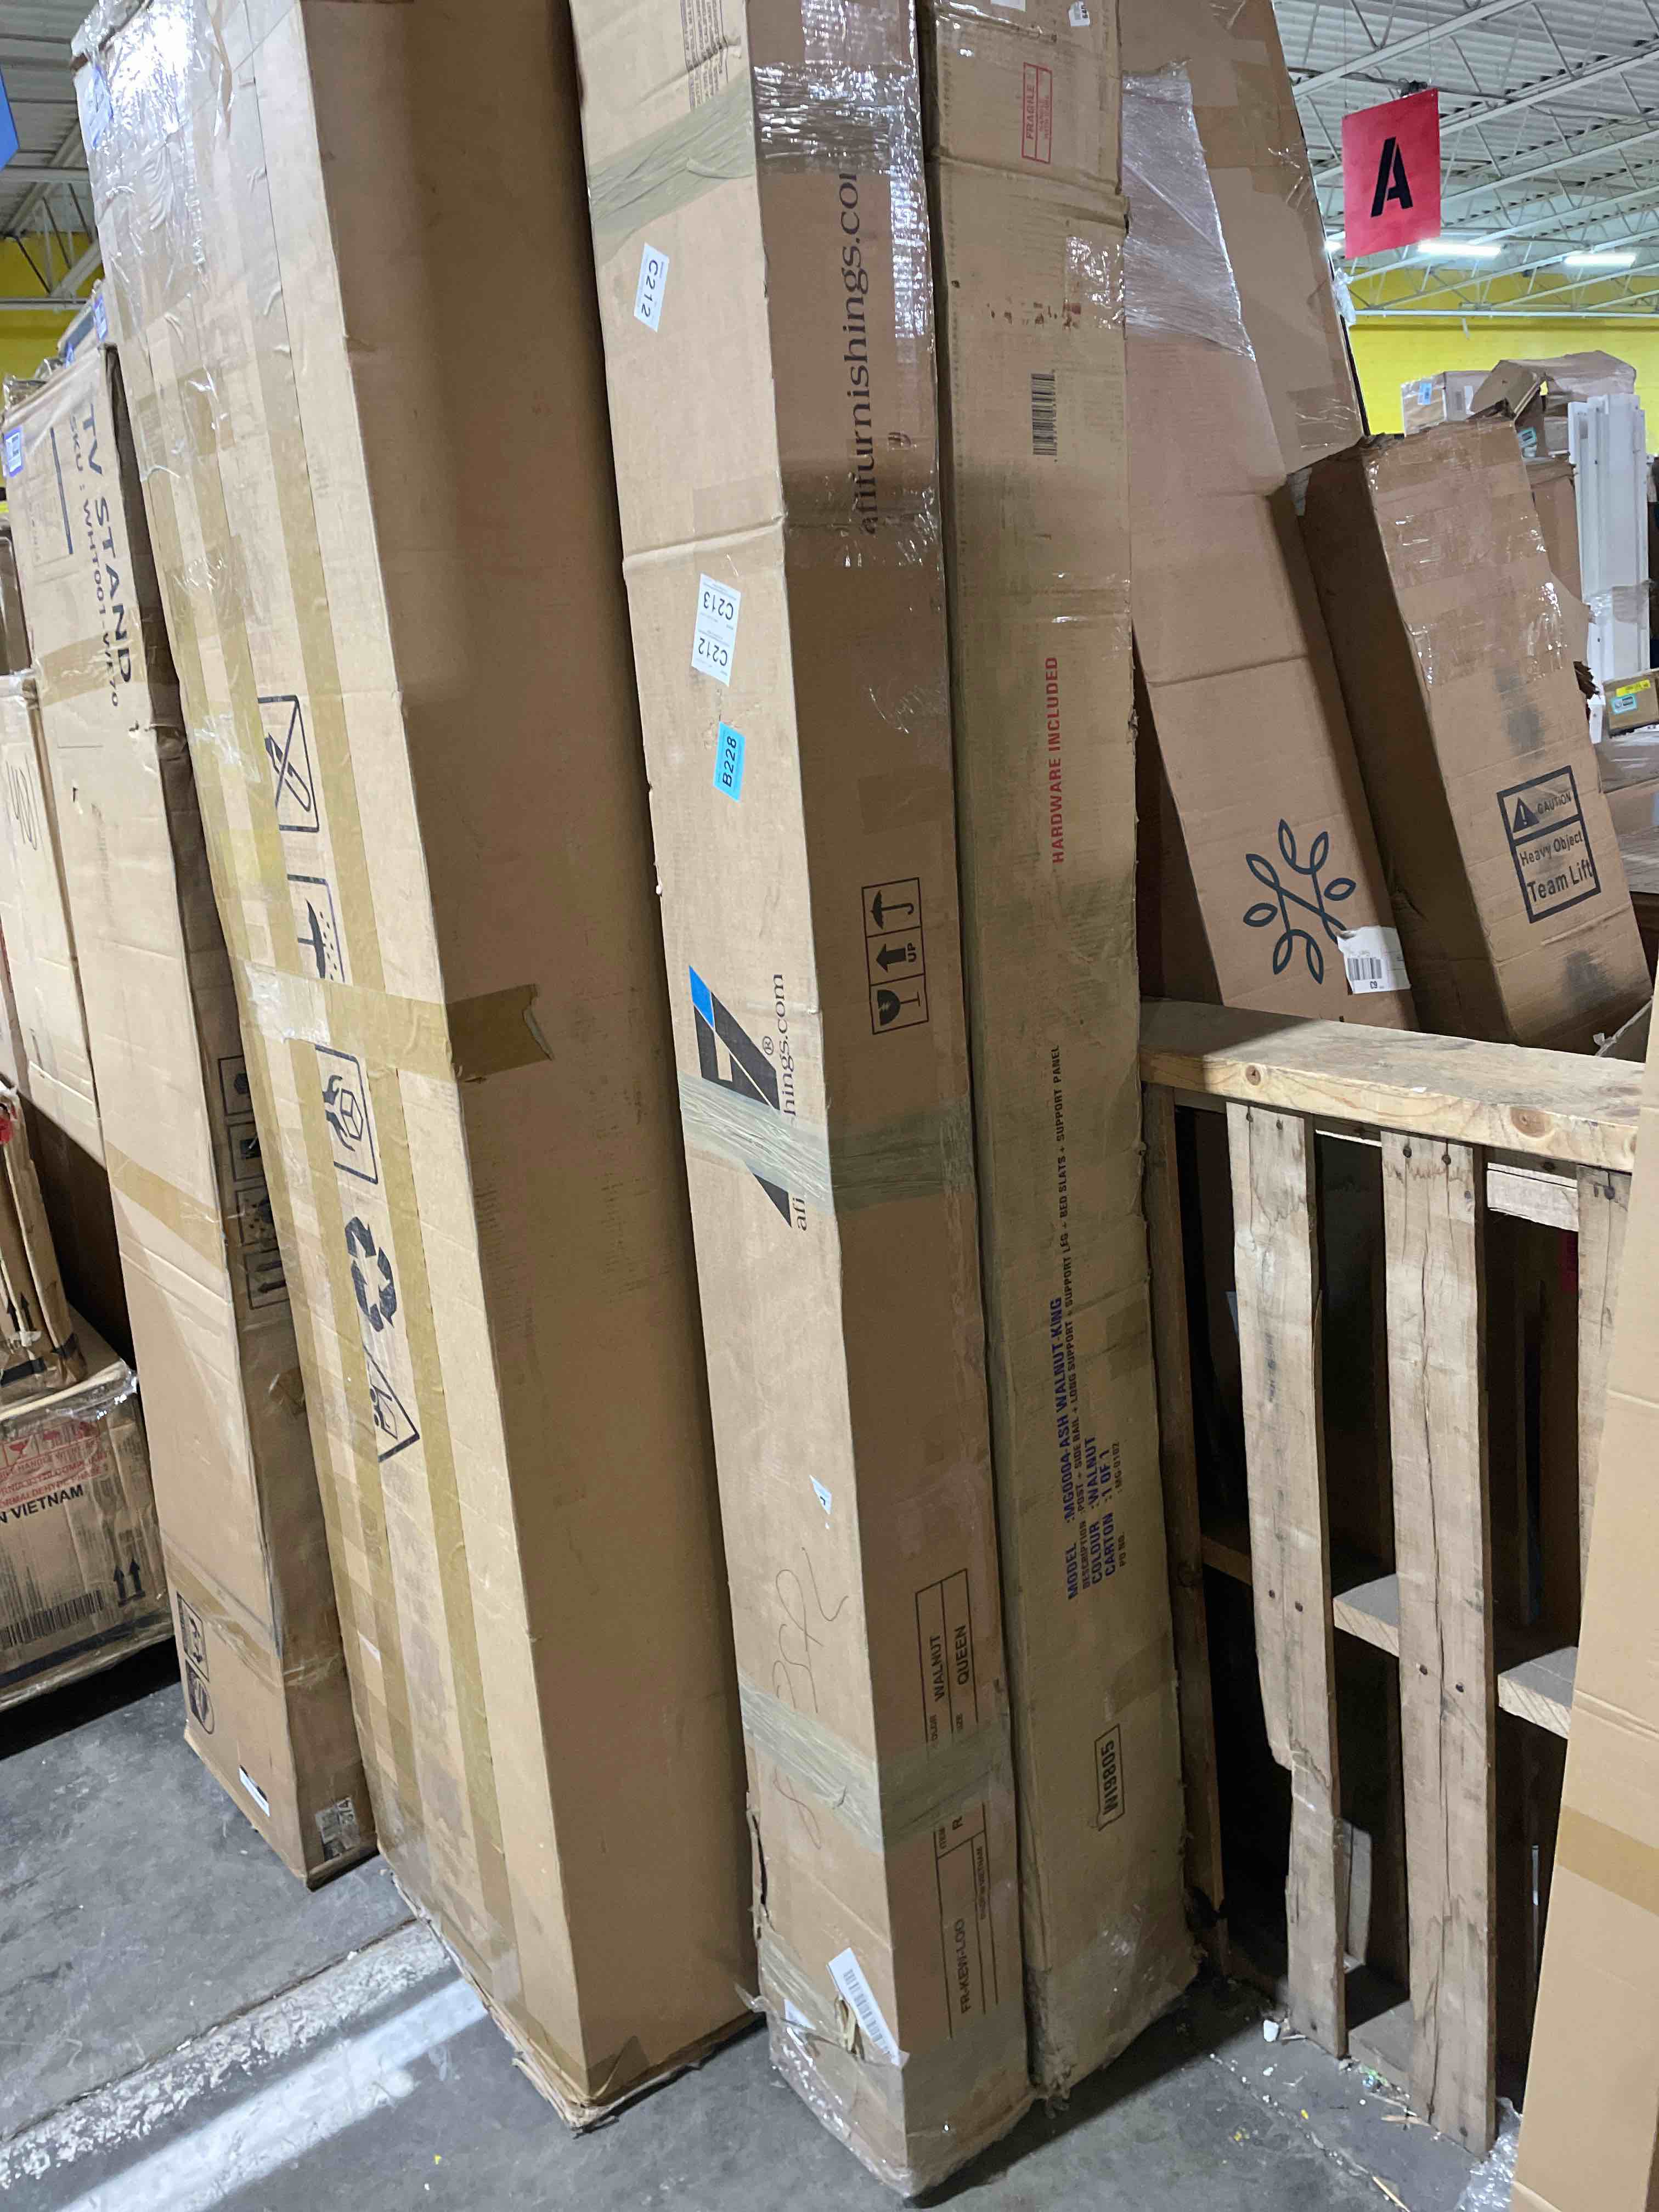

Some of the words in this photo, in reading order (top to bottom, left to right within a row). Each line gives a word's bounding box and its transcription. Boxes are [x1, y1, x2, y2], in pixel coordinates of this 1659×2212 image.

[1026, 84, 1035, 140] FRAGILE
[1371, 136, 1413, 218] A
[641, 259, 658, 318] C212
[82, 402, 102, 475] TV
[94, 495, 131, 683] STAND
[703, 591, 734, 620] C213
[698, 637, 728, 667] C212
[1045, 657, 1060, 752] INCLUDED
[722, 735, 737, 787] B228
[1047, 757, 1064, 864] HARDWARE
[1519, 846, 1551, 866] Heavy
[1553, 830, 1583, 853] Object
[1527, 873, 1569, 902] Team
[1569, 859, 1594, 884] Lift
[907, 943, 917, 962] UP
[1051, 1045, 1062, 1084] PANEL
[1053, 1088, 1064, 1142] SUPPORT
[1057, 1156, 1067, 1194] SLATS
[1059, 1195, 1068, 1218] BED
[1060, 1232, 1071, 1252] LEG
[1063, 1257, 1073, 1308] SUPPORT
[1049, 1296, 1068, 1414] WALNUT-KING
[1064, 1321, 1076, 1372] SUPPORT
[1068, 1373, 1078, 1405] LONG
[1071, 1417, 1080, 1443] RAIL
[1074, 1443, 1082, 1469] SIDE
[1099, 1465, 1111, 1484] OF
[10, 1484, 84, 1519] VIETNAM
[1079, 1519, 1091, 1589] DESCRIPTION
[1089, 1521, 1102, 1584] COLOUR
[1102, 1511, 1115, 1576] CARTON
[1066, 1542, 1078, 1600] MODEL
[930, 1635, 944, 1702] WALNUT
[955, 1624, 970, 1685] QUEEN
